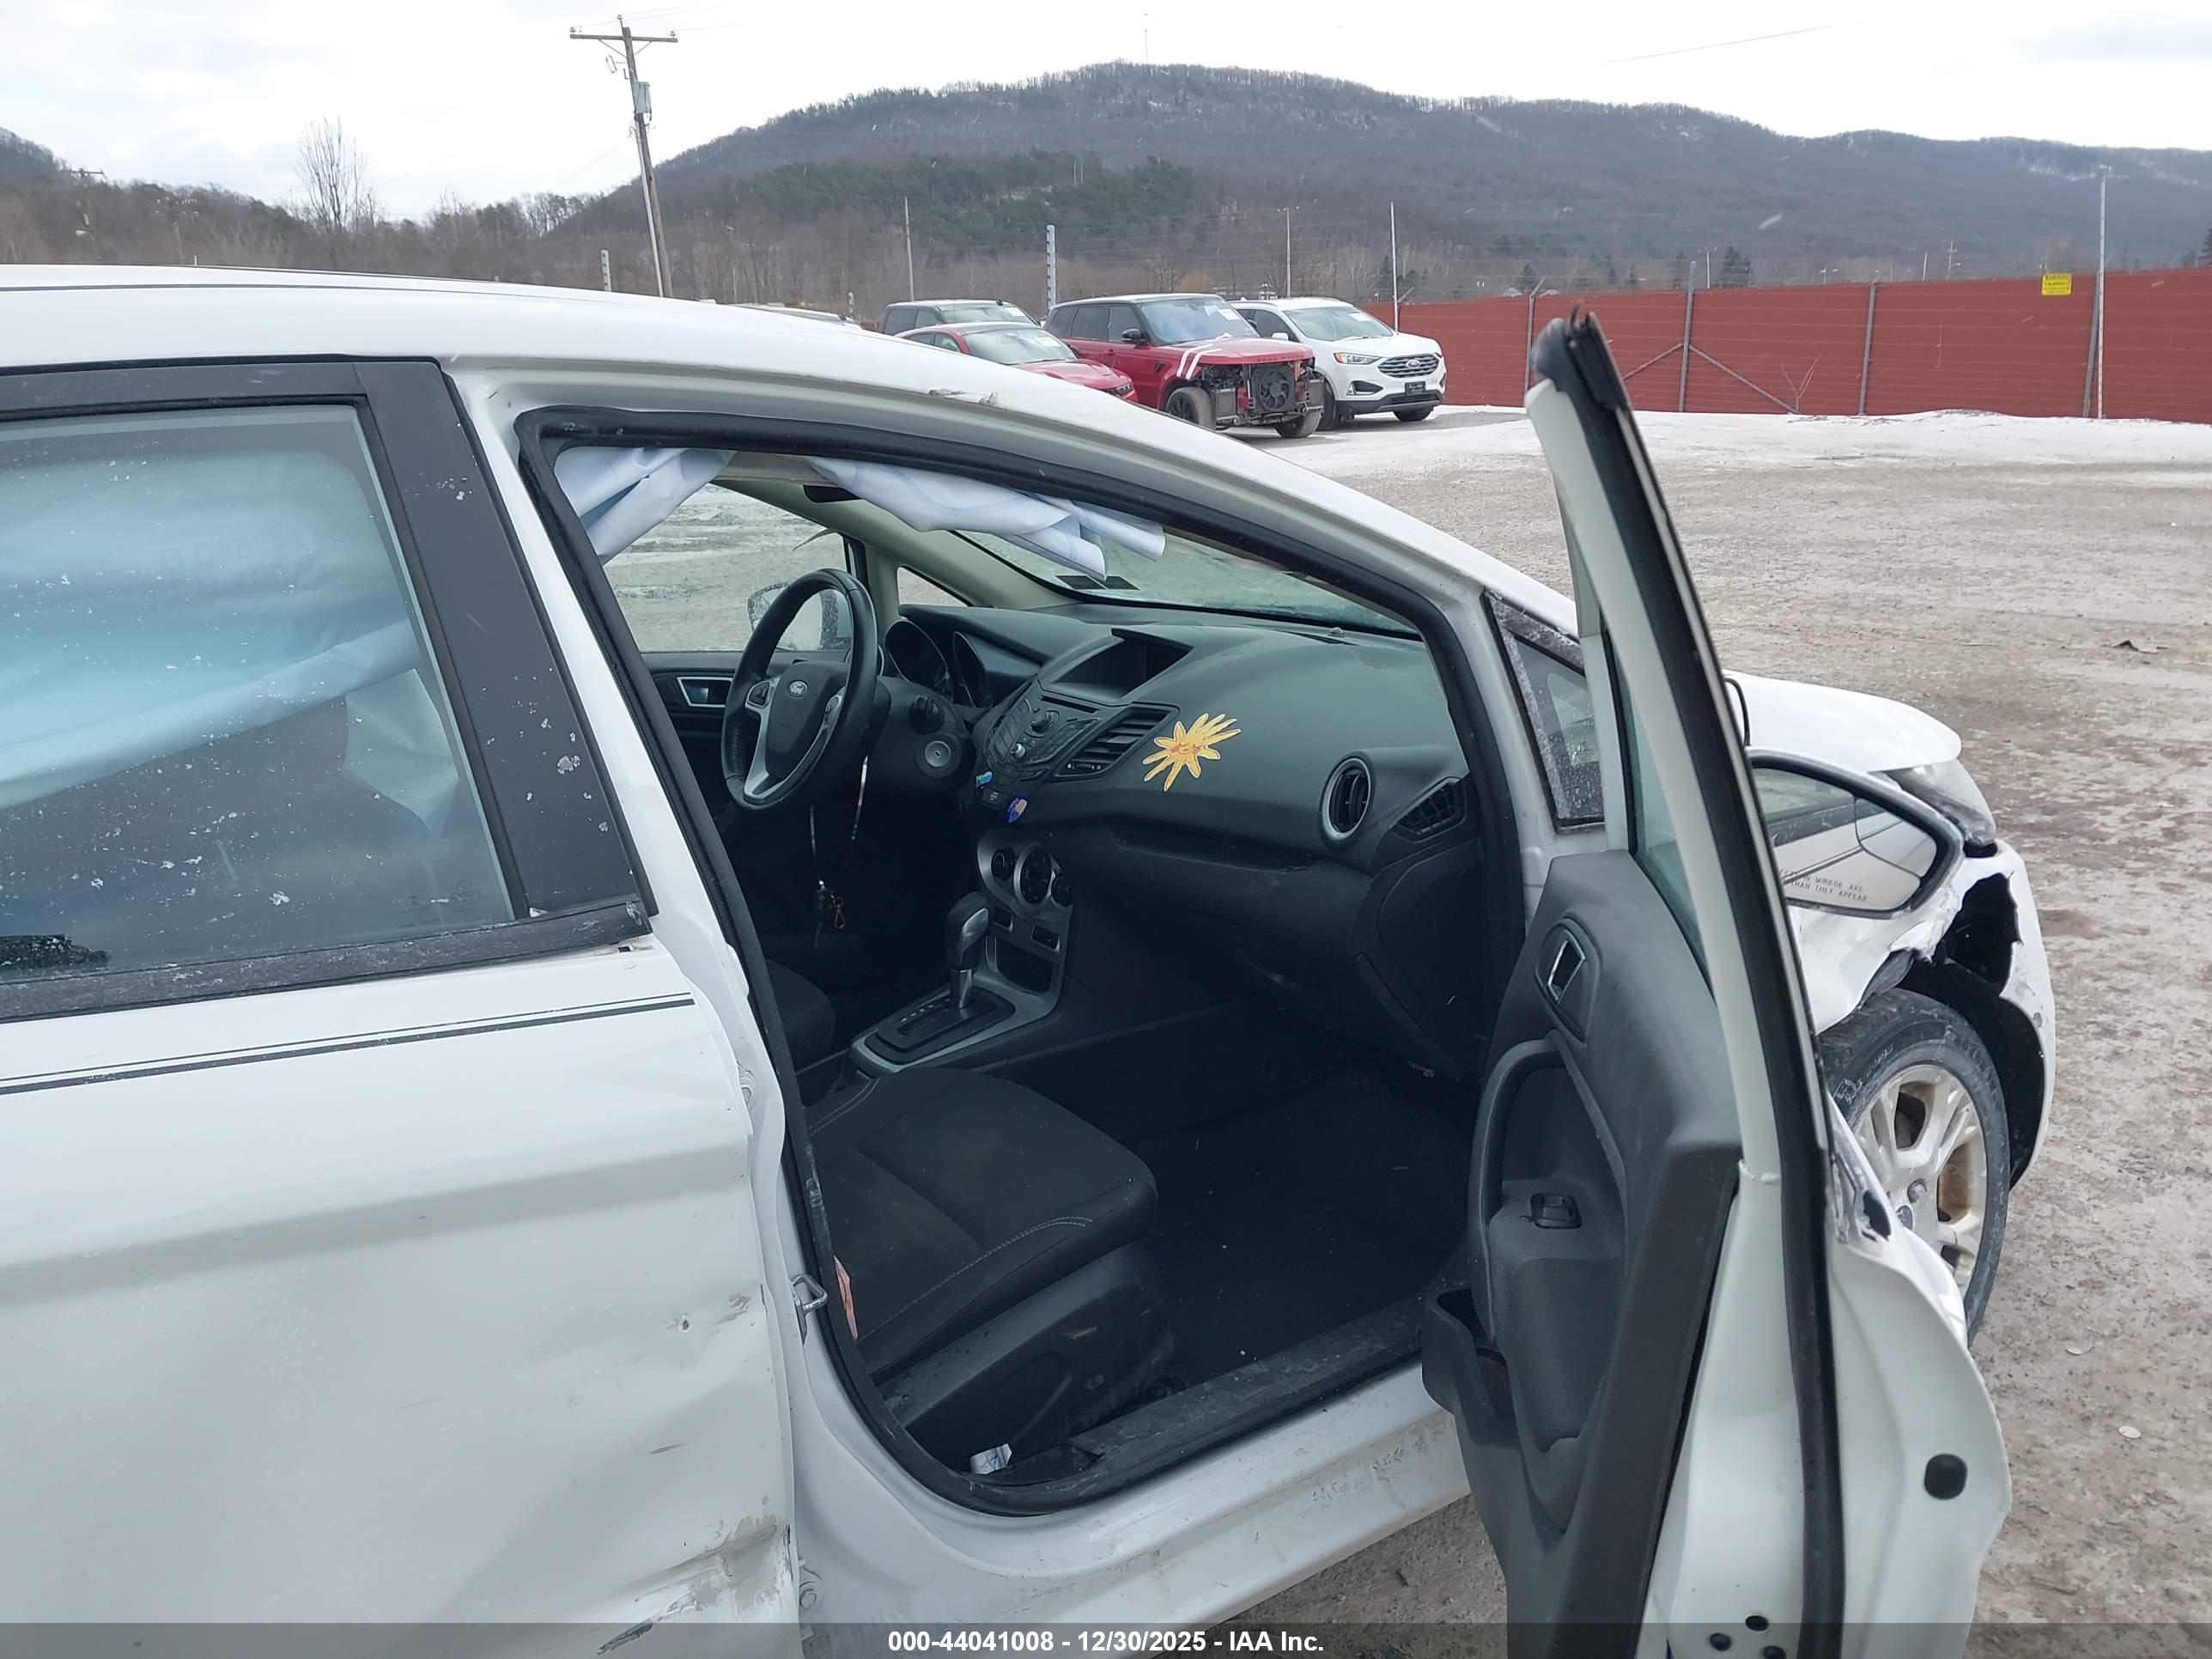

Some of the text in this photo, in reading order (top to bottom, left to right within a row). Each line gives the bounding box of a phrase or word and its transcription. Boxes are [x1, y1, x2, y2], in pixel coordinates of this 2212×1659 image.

[1815, 877, 1844, 887] MIRROR
[1848, 884, 1863, 893] ARE
[1838, 890, 1868, 902] APPEAR
